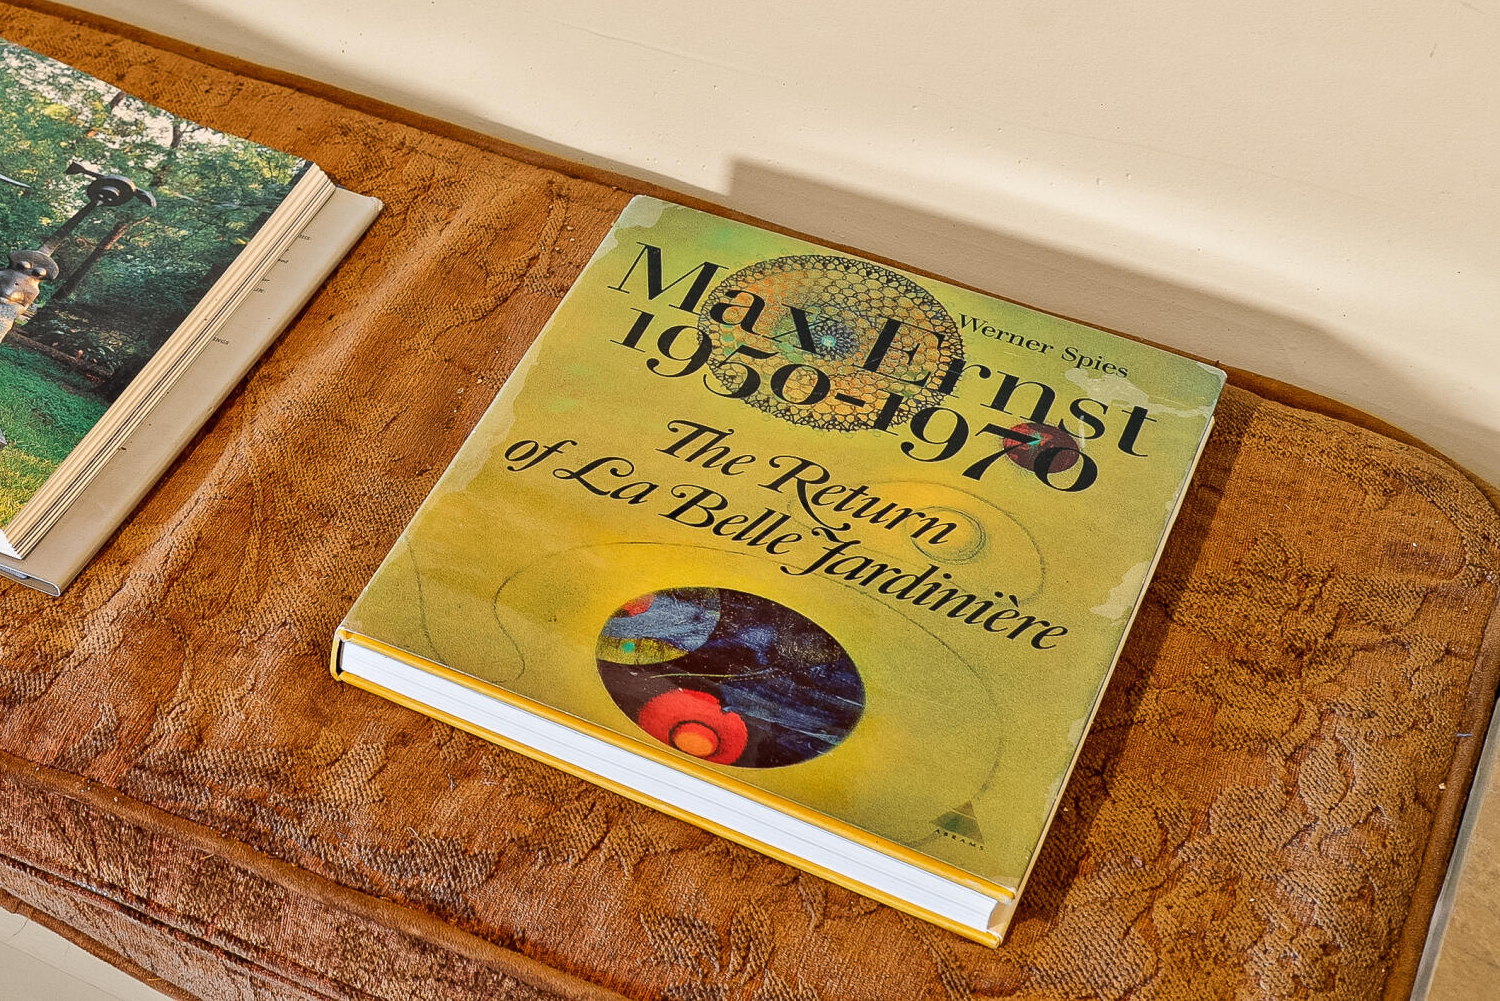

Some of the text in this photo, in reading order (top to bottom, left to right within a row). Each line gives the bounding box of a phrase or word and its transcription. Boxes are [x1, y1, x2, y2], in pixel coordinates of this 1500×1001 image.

[607, 241, 1158, 458] Max Ernst
[609, 307, 1099, 493] 1950-1970
[958, 312, 1129, 379] Werner Spies
[504, 439, 1069, 650] of La Belle Jardinière
[655, 419, 958, 545] The Return
[935, 828, 984, 851] ABRAMS
